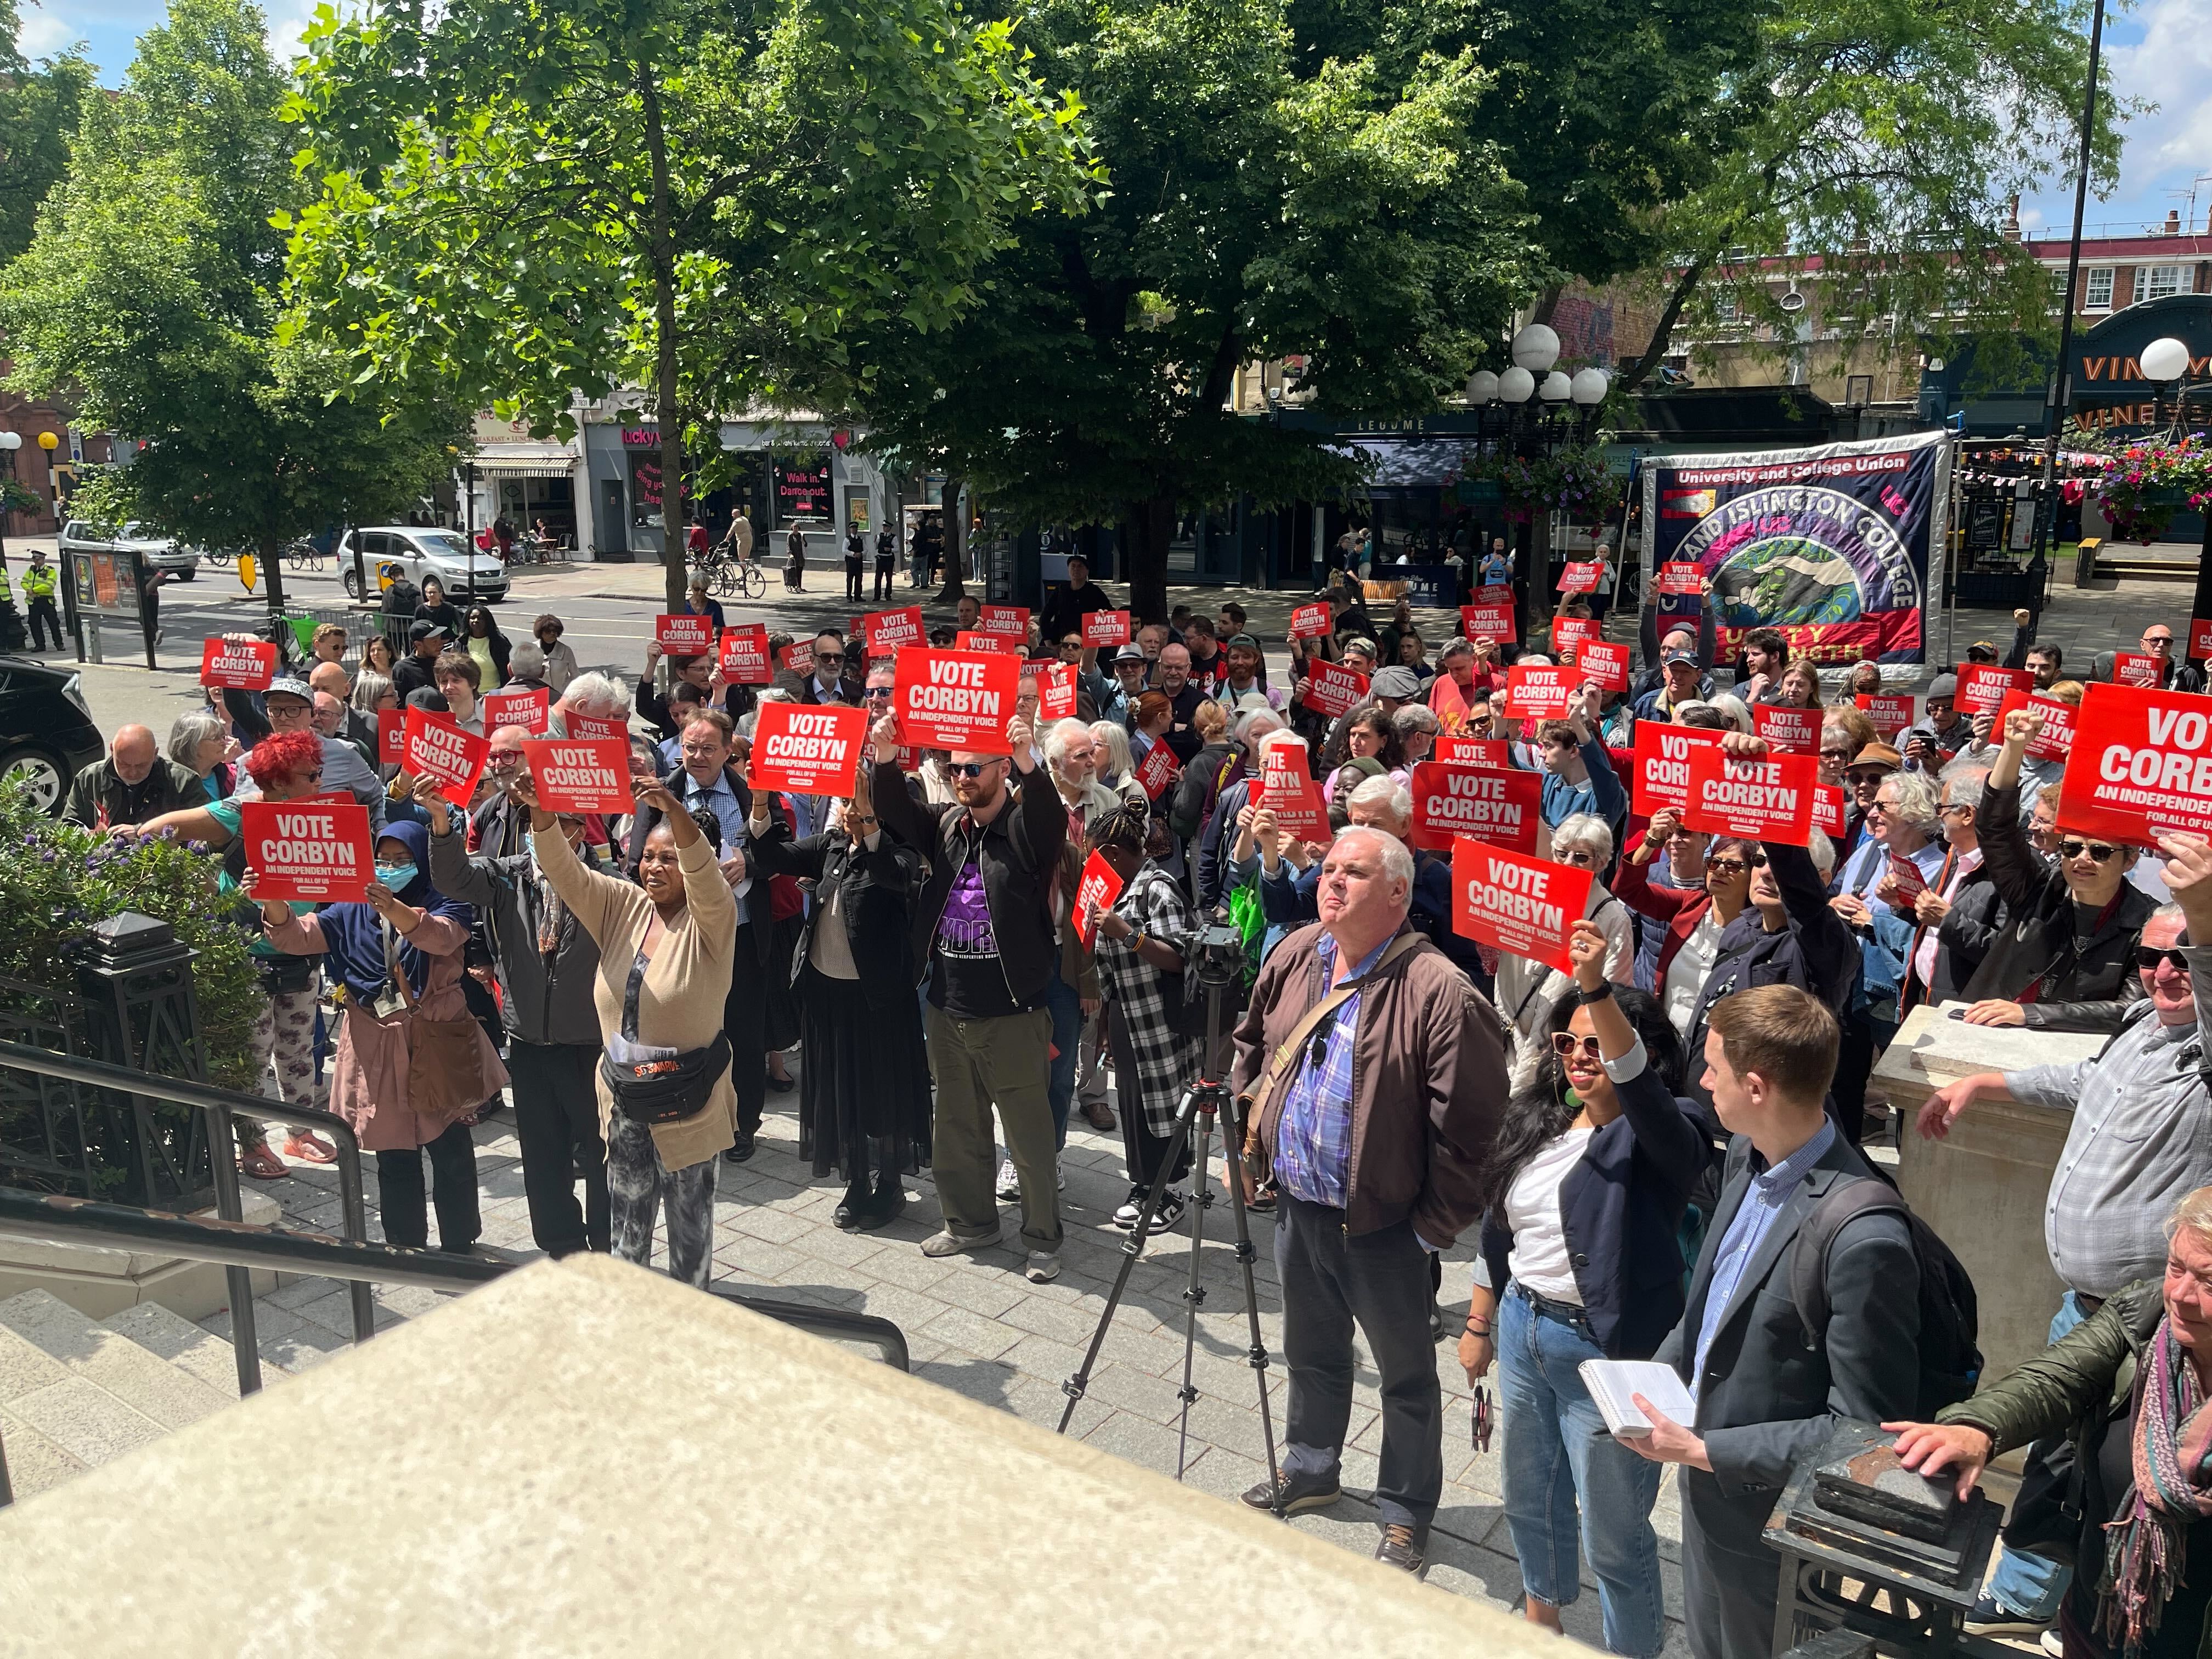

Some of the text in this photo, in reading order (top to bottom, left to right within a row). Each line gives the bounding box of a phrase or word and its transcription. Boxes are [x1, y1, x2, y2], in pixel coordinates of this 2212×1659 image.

[1679, 456, 1905, 483] University and College Union
[636, 469, 652, 489] Sing
[787, 473, 819, 483] Walk in.
[780, 485, 827, 496] Dance out.
[1684, 492, 1913, 609] AND ISLINGTON COLLEGE
[1672, 565, 1693, 573] VOTE
[1479, 591, 1510, 600] CORBYN
[882, 613, 907, 628] VOTE
[994, 610, 1016, 620] VOTE
[1294, 614, 1325, 627] CORBYN
[1300, 607, 1318, 618] VOTE
[1474, 610, 1498, 619] VOTE
[671, 619, 697, 629] VOTE
[875, 624, 918, 640] CORBYN
[986, 619, 1023, 630] CORBYN
[1088, 624, 1124, 634] CORBYN
[1469, 620, 1508, 629] CORBYN
[1563, 622, 1586, 632] VOTE
[663, 630, 705, 640] CORBYN
[1726, 626, 1826, 644] UTY
[224, 645, 257, 658] VOTE
[730, 641, 755, 653] VOTE
[969, 637, 997, 650] VOTE
[725, 653, 764, 666] CORBYN
[1588, 645, 1613, 660] VOTE
[1725, 644, 1863, 662] SNGTH
[211, 657, 264, 672] CORBYN
[1022, 664, 1043, 674] VOTE
[1581, 656, 1620, 674] CORBYN
[2120, 665, 2158, 678] CORBYN
[2129, 658, 2152, 669] VOTE
[930, 660, 985, 687] VOTE
[1327, 668, 1356, 689] VOTE
[1526, 672, 1558, 685] VOTE
[1979, 670, 2012, 686] VOTE
[1046, 685, 1072, 701] CORBYN
[1314, 679, 1361, 703] CORBYN
[1513, 685, 1566, 699] CORBYN
[506, 697, 535, 711] VOTE
[909, 685, 1000, 715] CORBYN
[1870, 699, 1898, 710] VOTE
[495, 707, 542, 723] CORBYN
[908, 710, 998, 727] AN INDEPENDENT VOICE
[1769, 711, 1802, 726] VOTE
[580, 720, 610, 734] VOTE
[789, 714, 837, 736] VOTE
[1761, 723, 1812, 739] CORBYN
[425, 723, 466, 754] VOTE
[766, 735, 847, 760] CORBYN
[1453, 744, 1486, 759] VOTE
[411, 736, 473, 777] CORBYN
[550, 748, 599, 766] VOTE
[764, 757, 843, 771] AN INDEPENDENT VOICE
[1144, 751, 1160, 773] VOTE
[543, 768, 617, 786] CORBYN
[1147, 752, 1170, 786] CORBYN
[1723, 758, 1781, 785] VOTE
[2099, 744, 2212, 794] CORB
[557, 787, 600, 795] INDEPENDENT
[1447, 774, 1505, 799] VOTE
[1646, 782, 1657, 793] AN
[1702, 780, 1797, 810] CORBYN
[2094, 785, 2212, 815] AN INDEPENDE
[1426, 795, 1521, 825] CORBYN
[1701, 802, 1795, 821] AN INDEPENDENT VOICE
[276, 815, 335, 839] VOTE
[1425, 817, 1520, 835] AN INDEPENDENT VOICE
[2146, 811, 2167, 822] FOR
[2168, 815, 2186, 826] ALL
[2188, 818, 2202, 828] OF
[262, 840, 356, 865] CORBYN
[266, 865, 357, 876] AN INDEPENDENT VOICE
[1488, 857, 1549, 899] VOTE
[1079, 874, 1093, 911] VOTE
[1468, 880, 1564, 932] CORBYN
[1469, 905, 1562, 944] AN INDEPENDENT VOICE
[1496, 926, 1506, 934] FOR
[1506, 929, 1516, 937] ALL
